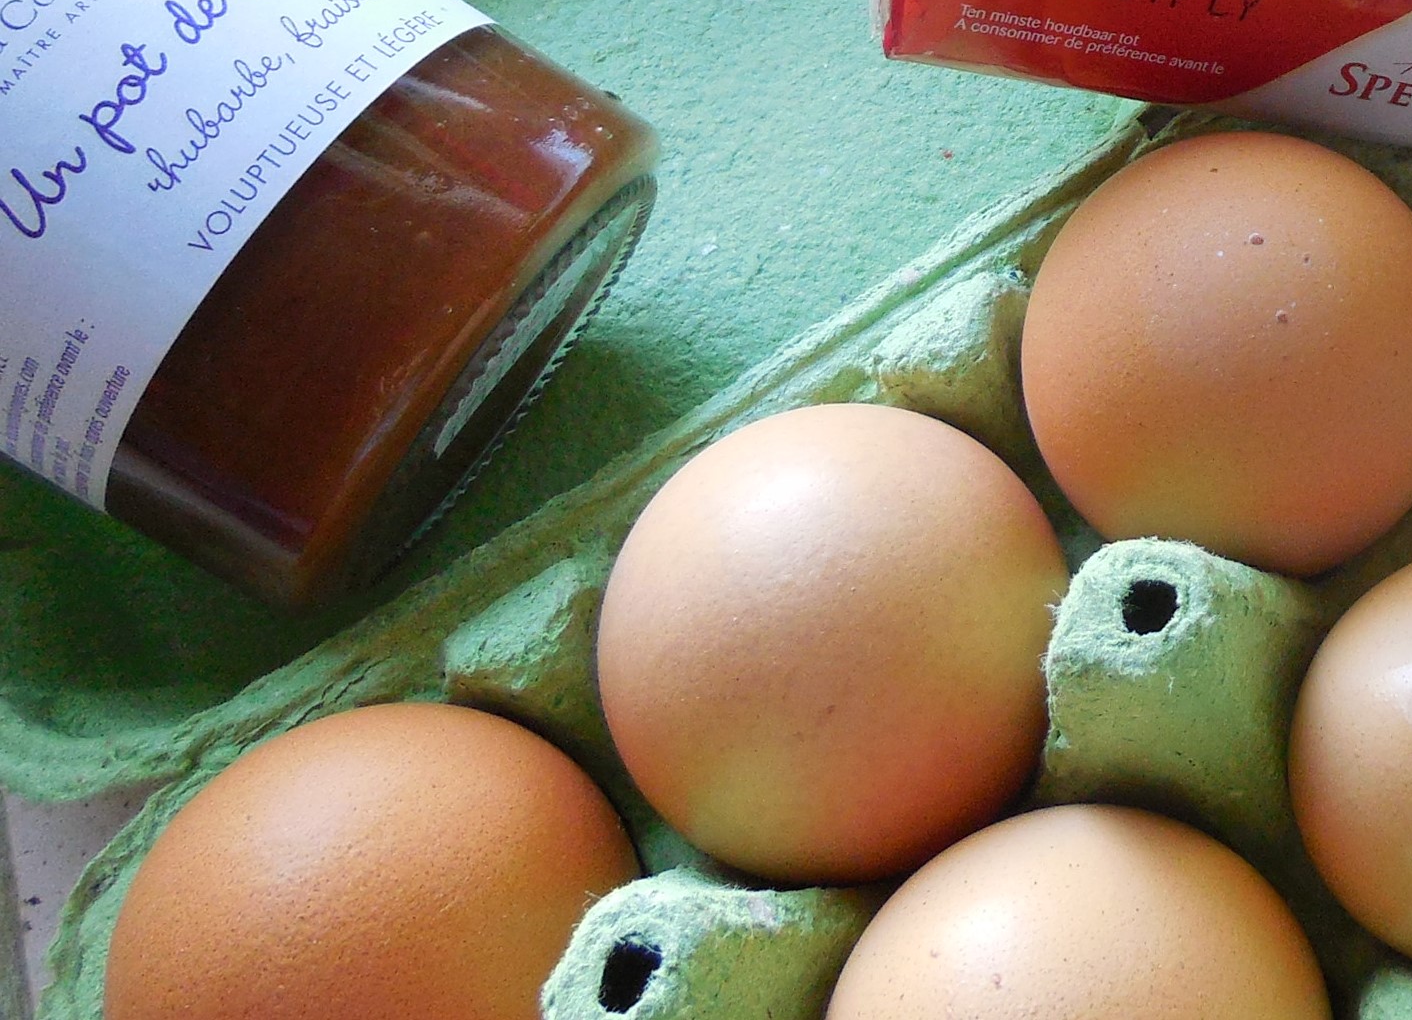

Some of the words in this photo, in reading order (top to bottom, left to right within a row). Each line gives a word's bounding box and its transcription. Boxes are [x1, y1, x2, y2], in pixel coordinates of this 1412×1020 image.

[960, 2, 987, 21] Ten
[990, 9, 1042, 31] minste
[1044, 17, 1117, 43] houdbaar
[1118, 32, 1140, 47] tot
[970, 22, 1062, 47] consommer
[1063, 35, 1083, 51] de
[1085, 38, 1167, 66] préférence
[1168, 56, 1209, 73] avant
[1211, 62, 1225, 75] le
[0, 145, 87, 239] Un
[78, 42, 168, 155] pot
[187, 79, 352, 252] VOLUPTUEUSE
[344, 52, 379, 83] ET
[371, 9, 444, 59] LÉGÈRE
[94, 365, 131, 419] ouverture
